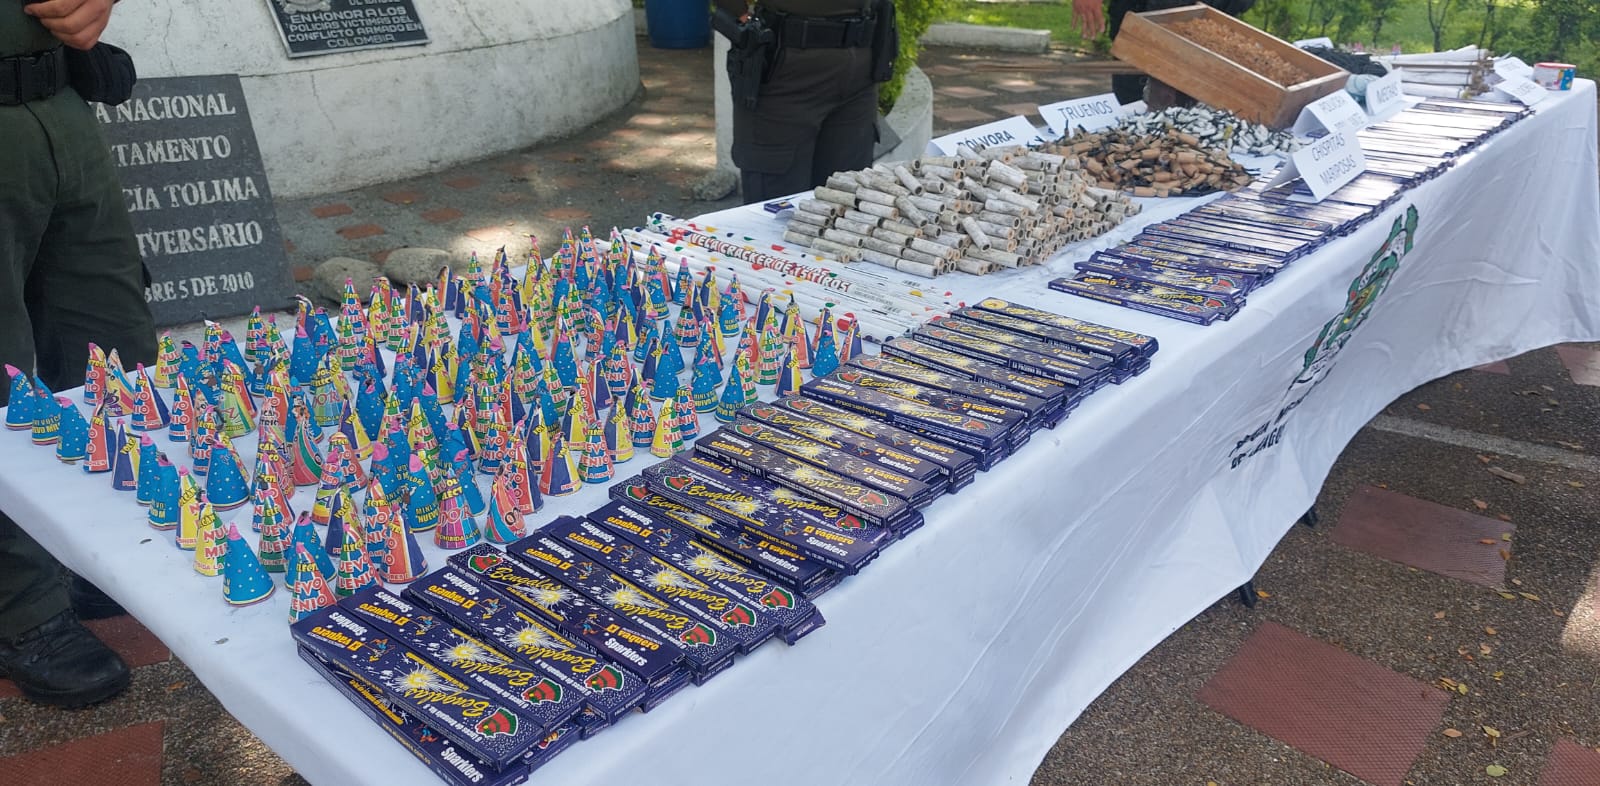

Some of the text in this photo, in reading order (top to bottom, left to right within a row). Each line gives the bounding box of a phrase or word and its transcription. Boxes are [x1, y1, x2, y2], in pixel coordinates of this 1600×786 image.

[313, 9, 363, 21] HONOR
[365, 8, 377, 17] A
[378, 6, 407, 16] LOS
[393, 15, 414, 24] DEL
[287, 28, 354, 43] CONFLICTO
[357, 24, 405, 35] ARMADO
[327, 33, 396, 48] COLOMBIA
[116, 92, 236, 123] NACIONAL
[1057, 99, 1114, 121] TRUENOS
[1311, 132, 1346, 161] CHISPITAS
[163, 176, 260, 208] TOLIMA
[690, 233, 718, 250] VELA
[720, 243, 774, 268] CRACKER
[808, 272, 852, 292] TIROS
[178, 279, 190, 299] 5
[190, 275, 218, 297] DE
[219, 271, 255, 294] 2010
[617, 505, 653, 525] Sparklers
[580, 521, 615, 542] Sparklers
[537, 537, 574, 559] Sparklers
[806, 536, 848, 556] Sparklers
[759, 551, 800, 572] Sparklers
[443, 572, 480, 595] Sparklers
[489, 567, 562, 591] Bengalas
[695, 567, 767, 593] Bengalas
[374, 591, 413, 613] Sparklers
[428, 584, 466, 604] vaquero
[656, 584, 729, 610] Bengalas
[359, 603, 399, 621] vaquero
[614, 602, 689, 629] Bengalas
[328, 611, 368, 637] Sparklers
[311, 626, 353, 646] vaquero
[617, 629, 660, 651] vaquero
[516, 644, 597, 673] Bengalas
[605, 637, 647, 666] Sparklers
[452, 659, 535, 686] Bengalas
[403, 687, 490, 717] Bengalas
[440, 746, 484, 784] Sparklers
